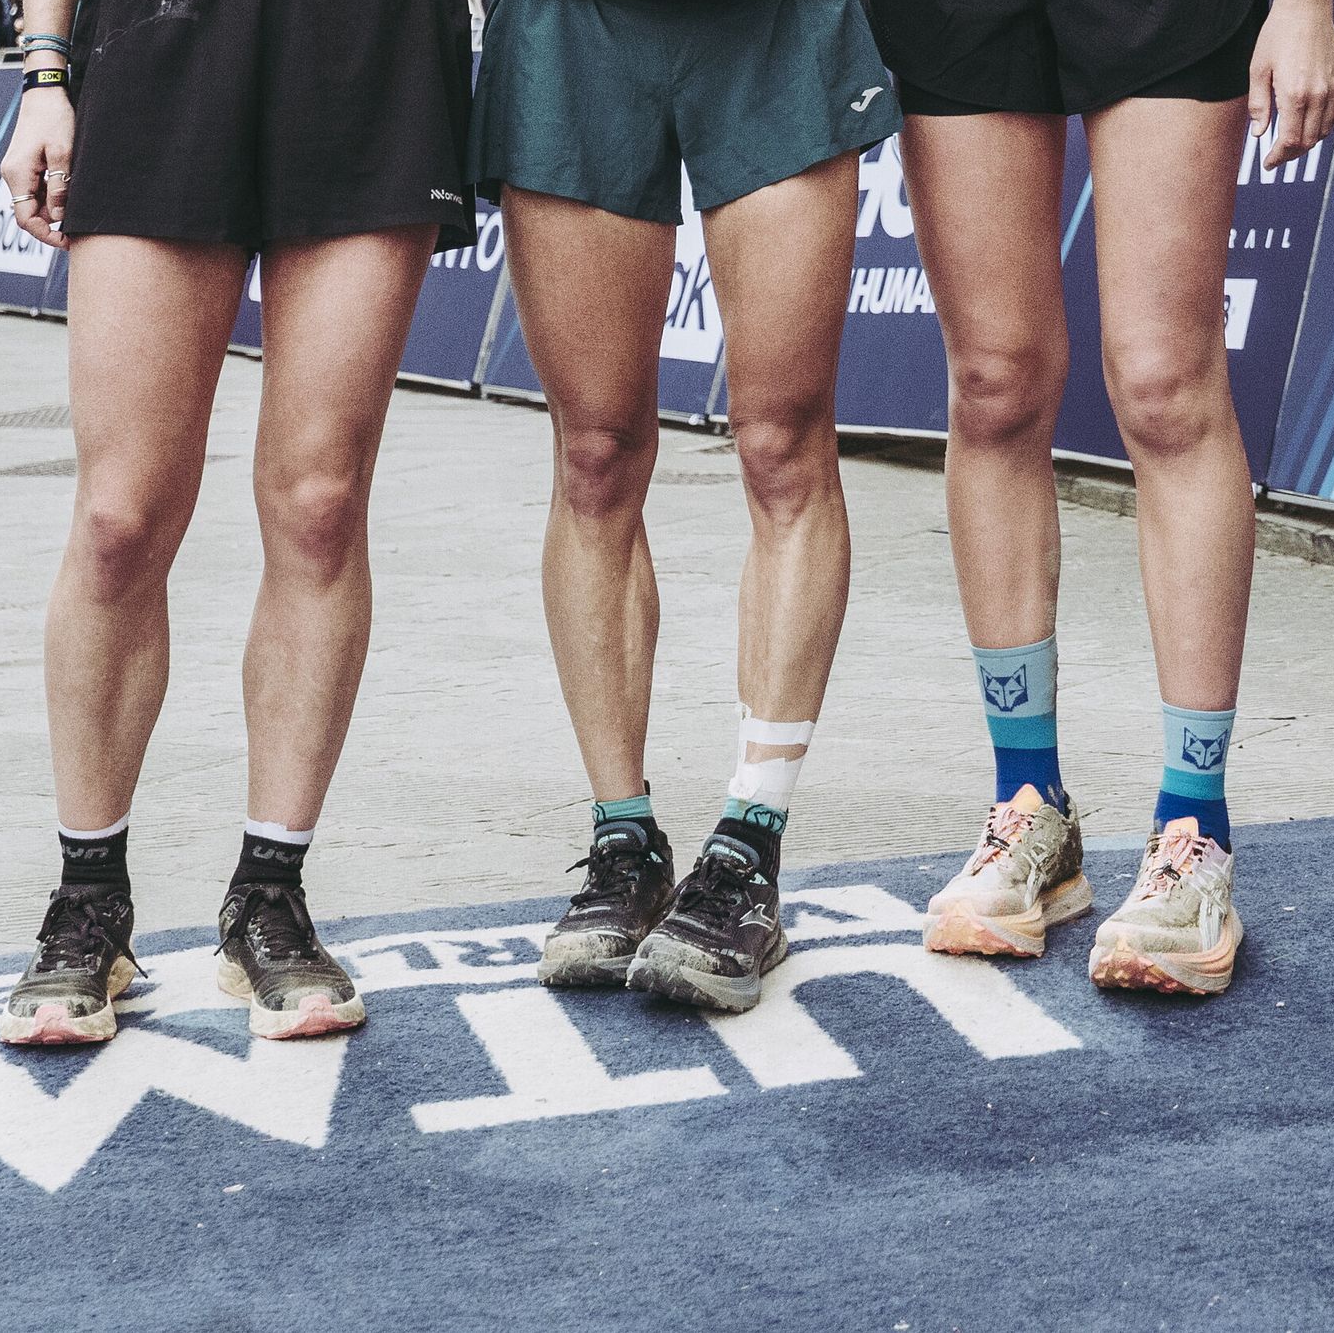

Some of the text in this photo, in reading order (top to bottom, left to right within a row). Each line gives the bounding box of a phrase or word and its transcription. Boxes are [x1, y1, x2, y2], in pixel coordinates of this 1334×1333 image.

[41, 71, 60, 81] 20K
[1229, 227, 1291, 248] RAIL
[847, 267, 936, 314] HUMA
